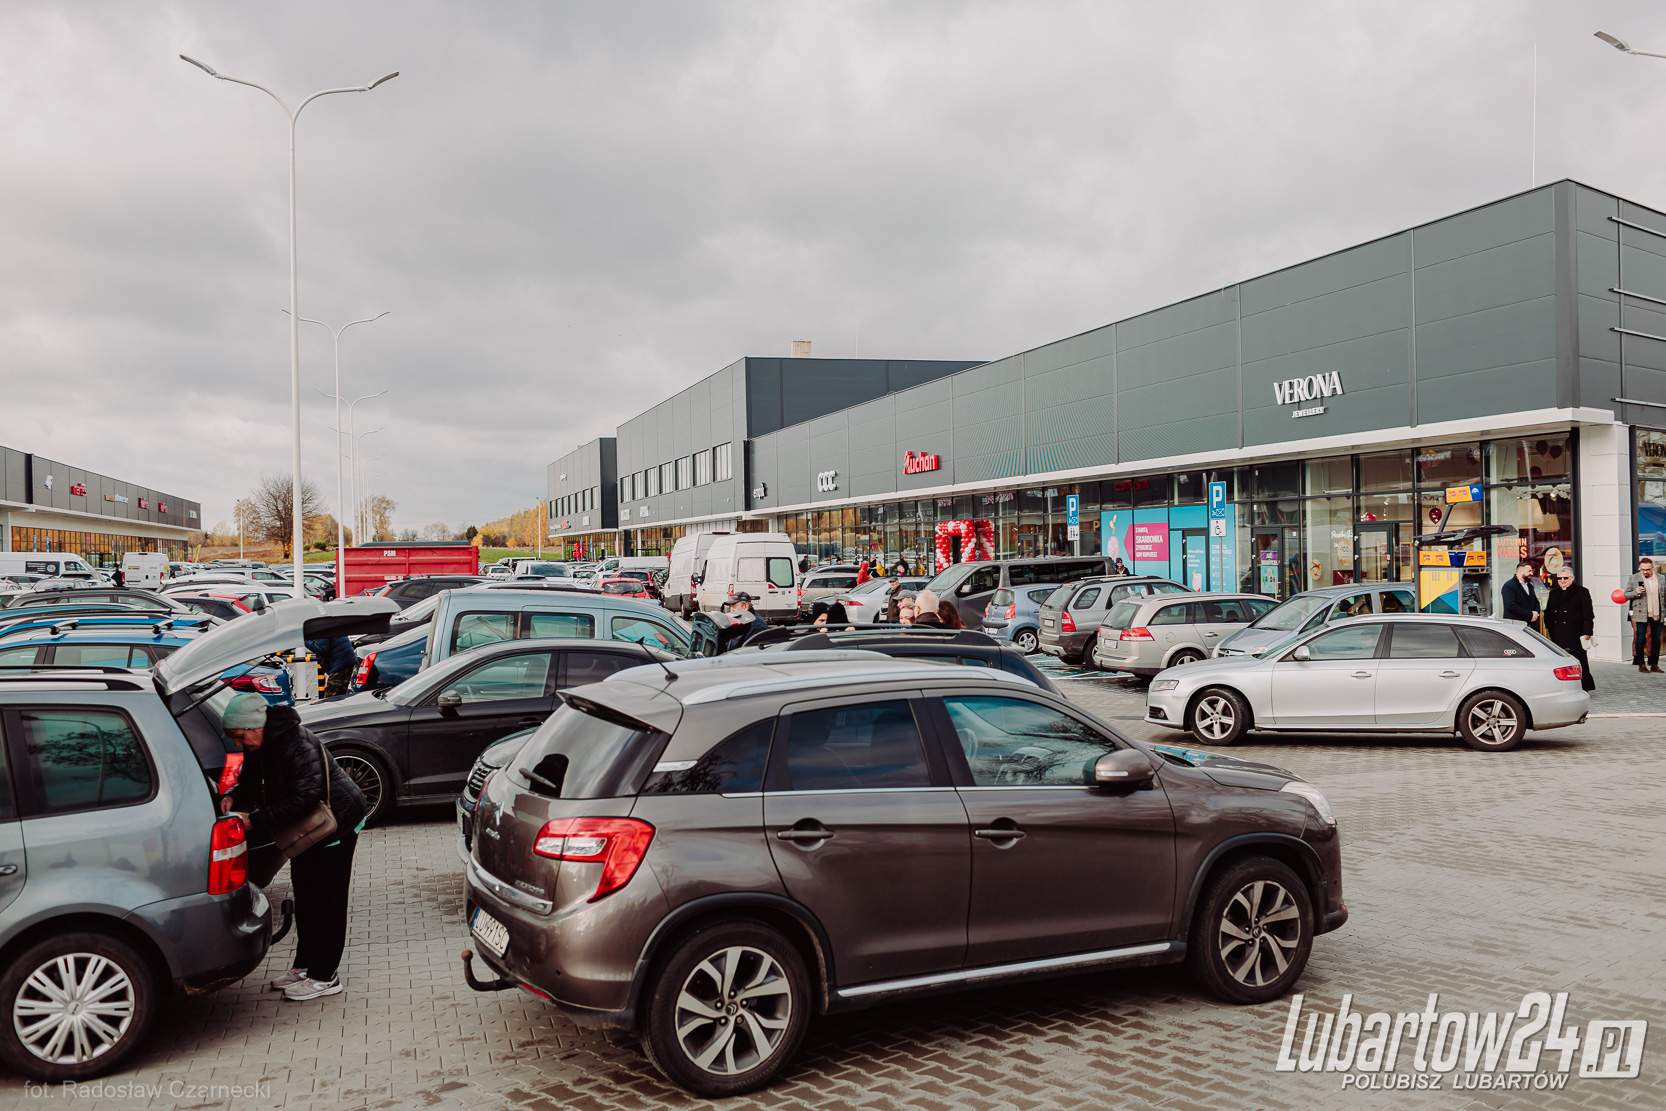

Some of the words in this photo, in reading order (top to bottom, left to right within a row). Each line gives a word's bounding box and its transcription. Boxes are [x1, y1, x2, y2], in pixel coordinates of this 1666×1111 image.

[1273, 371, 1343, 405] VERONA
[903, 450, 940, 475] Auchan
[817, 470, 837, 492] CCC
[1069, 497, 1077, 518] P
[1212, 485, 1222, 509] P
